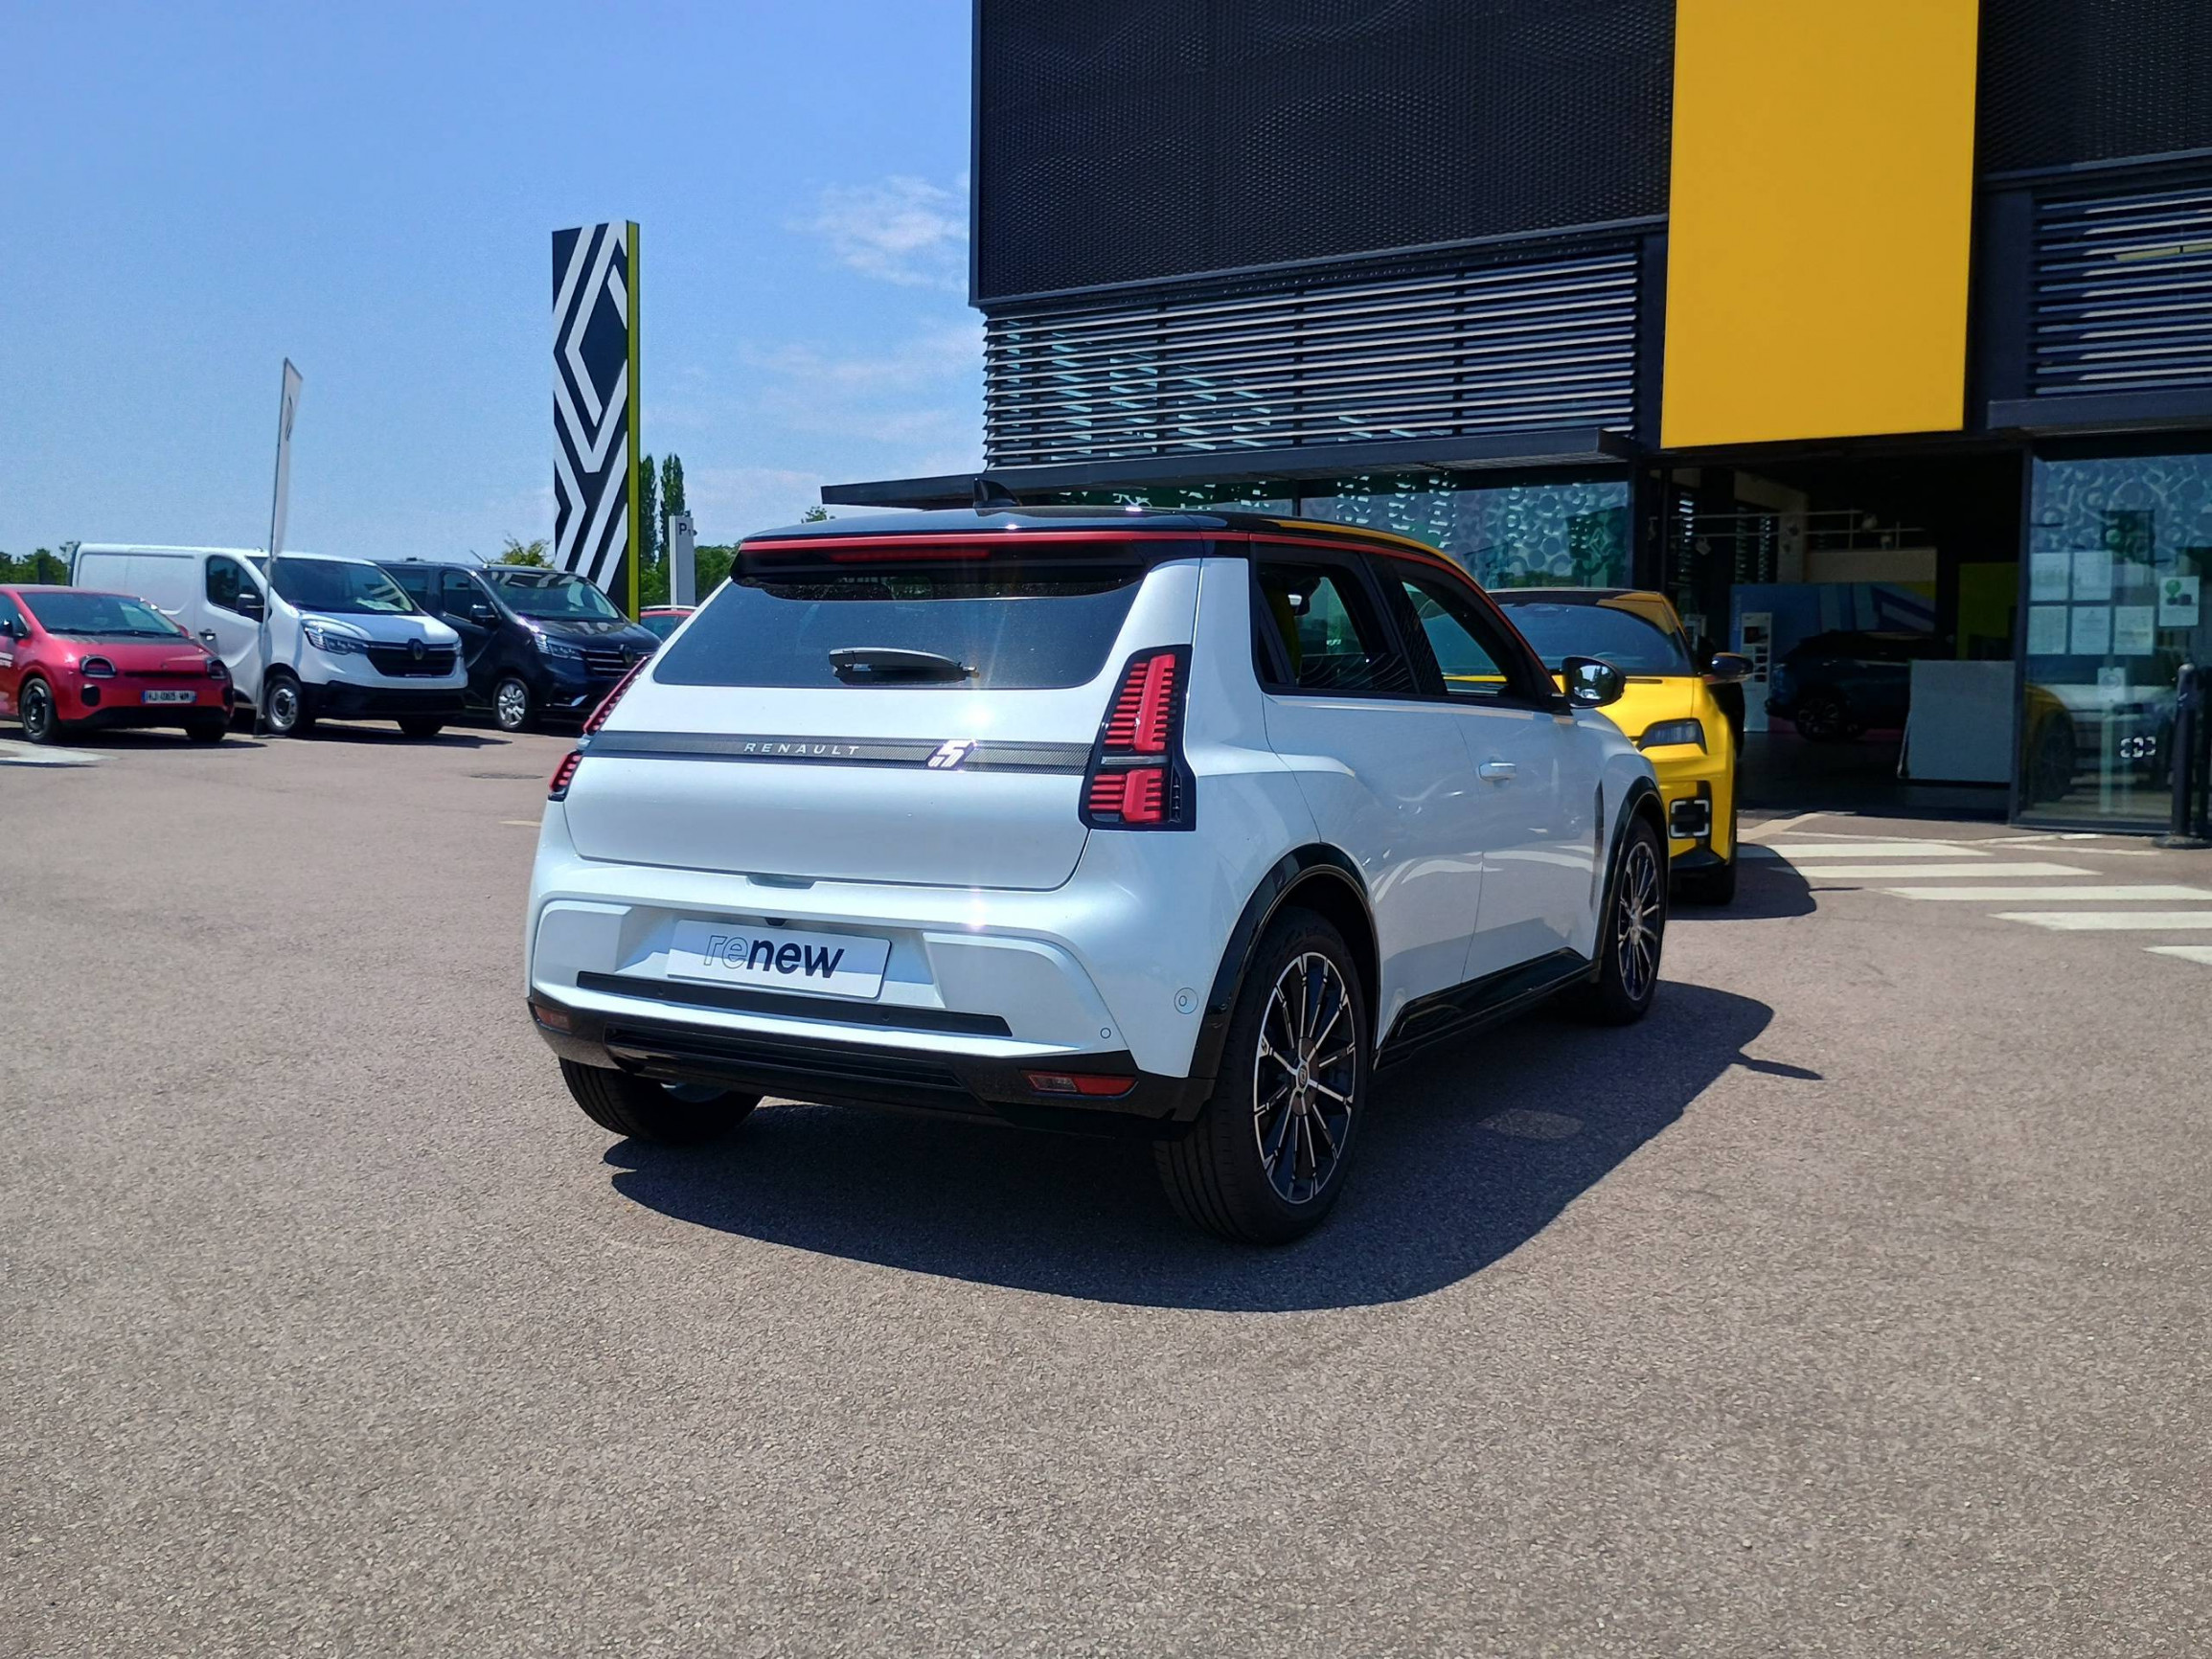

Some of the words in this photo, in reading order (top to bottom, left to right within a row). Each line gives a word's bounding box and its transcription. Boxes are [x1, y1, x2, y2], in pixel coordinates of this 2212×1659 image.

[743, 742, 860, 756] RENAULT
[927, 739, 973, 767] 5
[703, 934, 845, 979] renew
